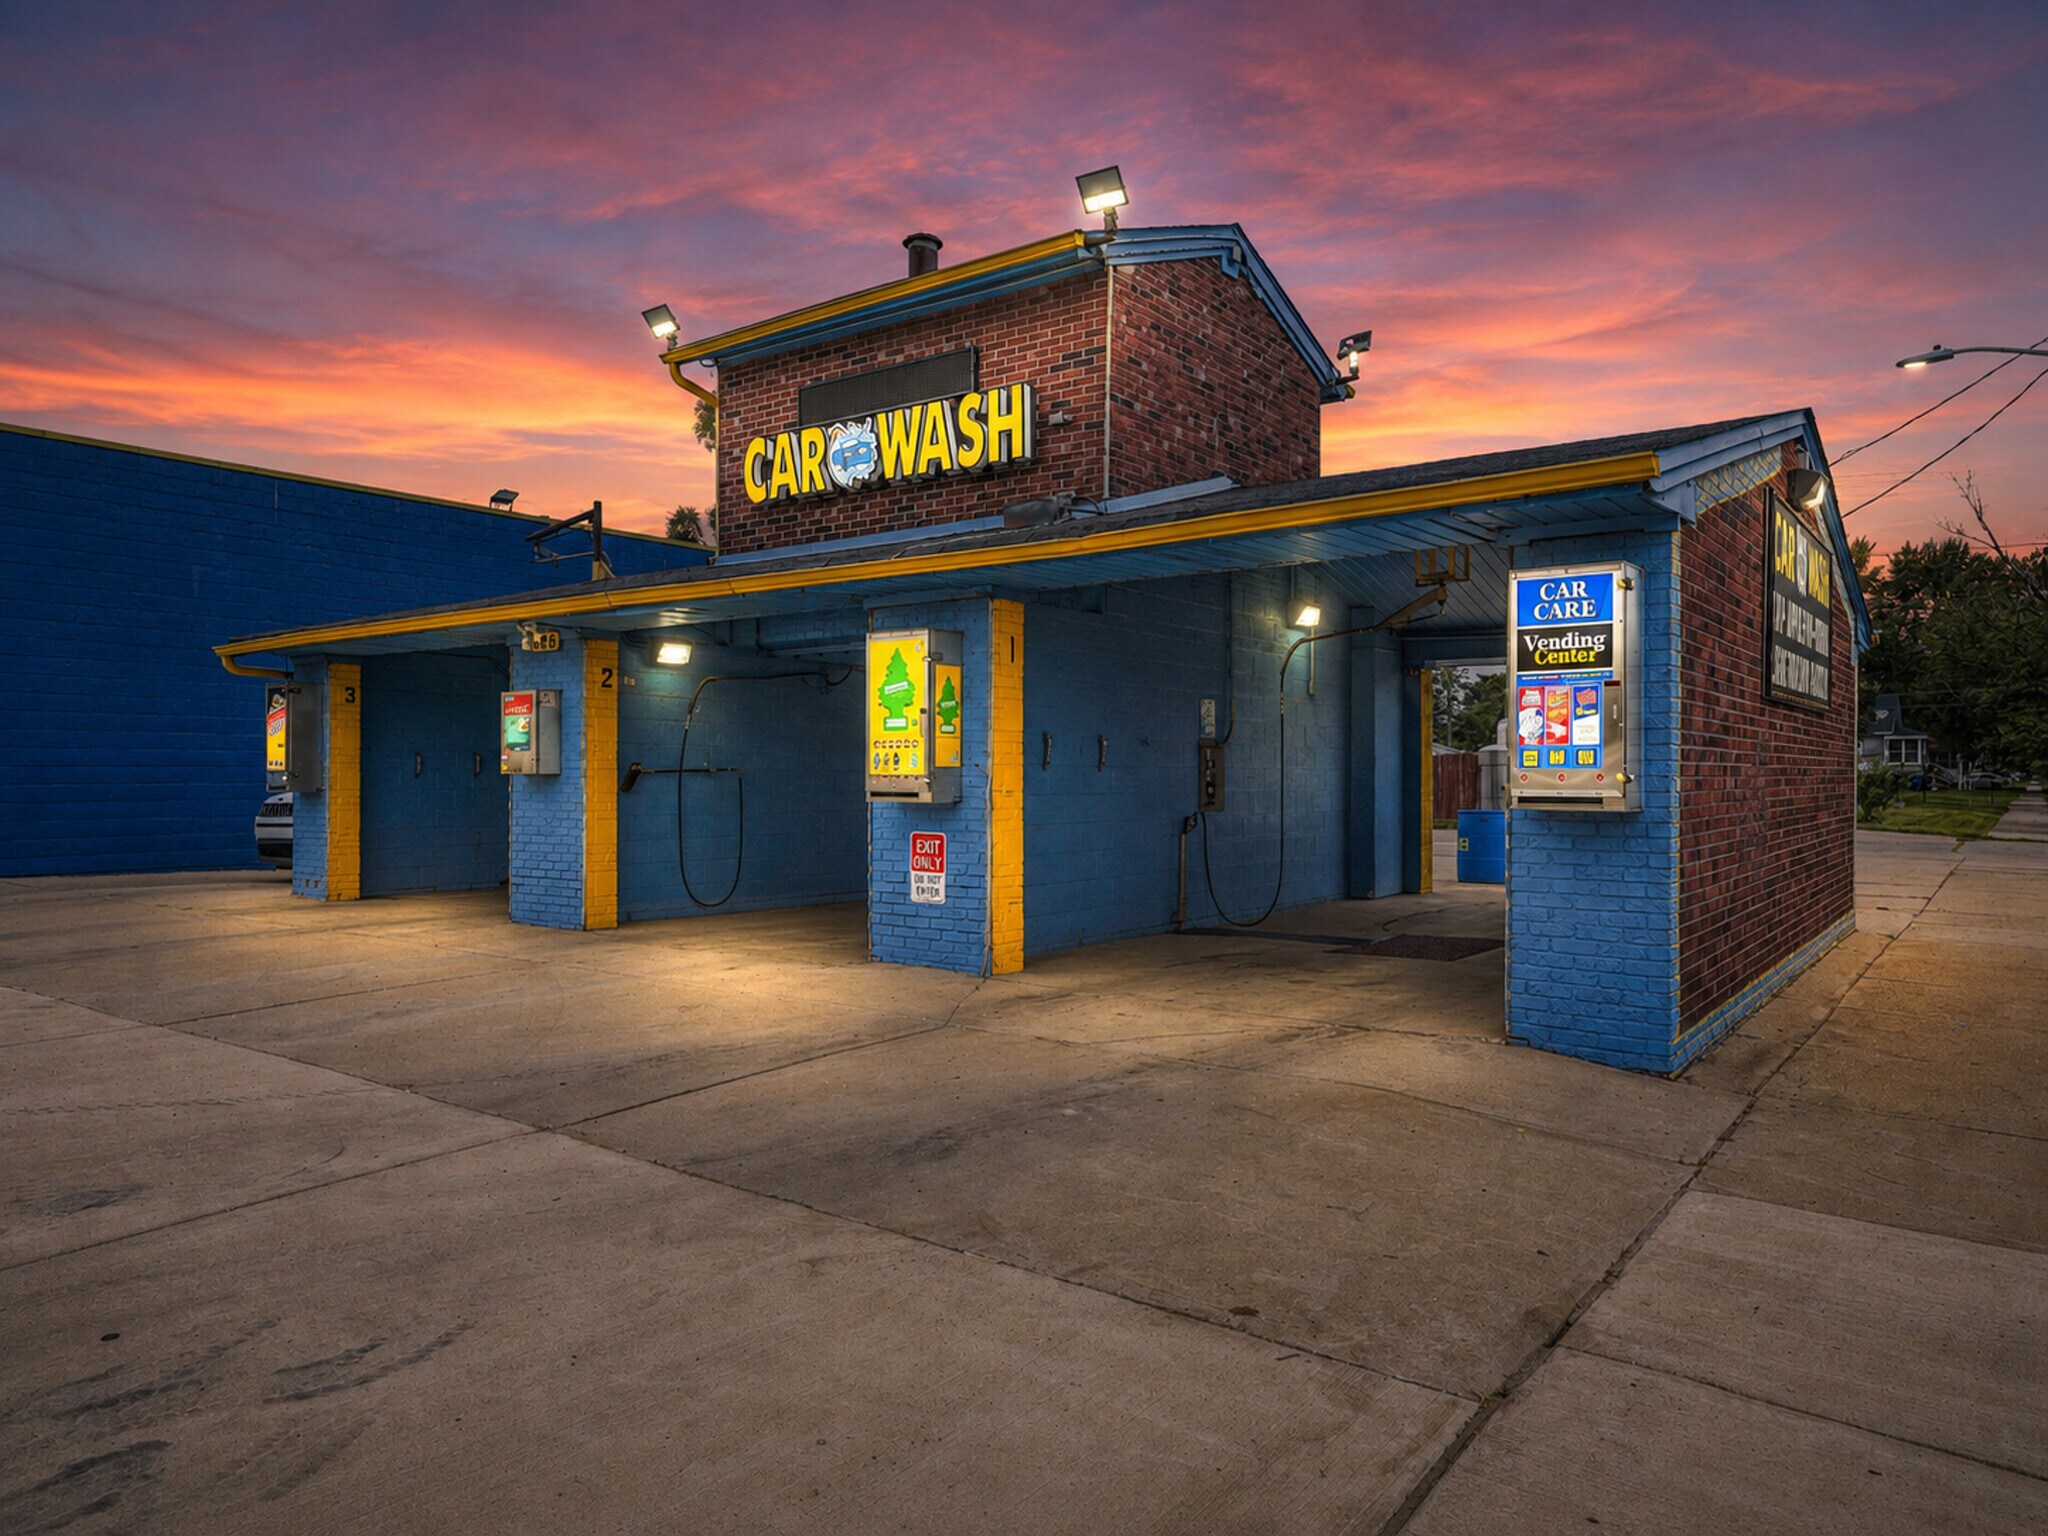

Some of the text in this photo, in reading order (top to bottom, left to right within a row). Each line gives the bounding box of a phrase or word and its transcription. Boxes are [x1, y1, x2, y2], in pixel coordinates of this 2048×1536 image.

[743, 382, 1024, 504] CAR WASH
[1774, 510, 1796, 583] CAR
[1540, 580, 1588, 601] CAR
[1533, 599, 1597, 620] CARE
[1523, 631, 1607, 652] Vending
[1534, 648, 1597, 666] Center
[601, 667, 613, 688] 2
[344, 686, 356, 704] 3
[916, 839, 941, 854] EXIT
[913, 855, 942, 871] ONLY
